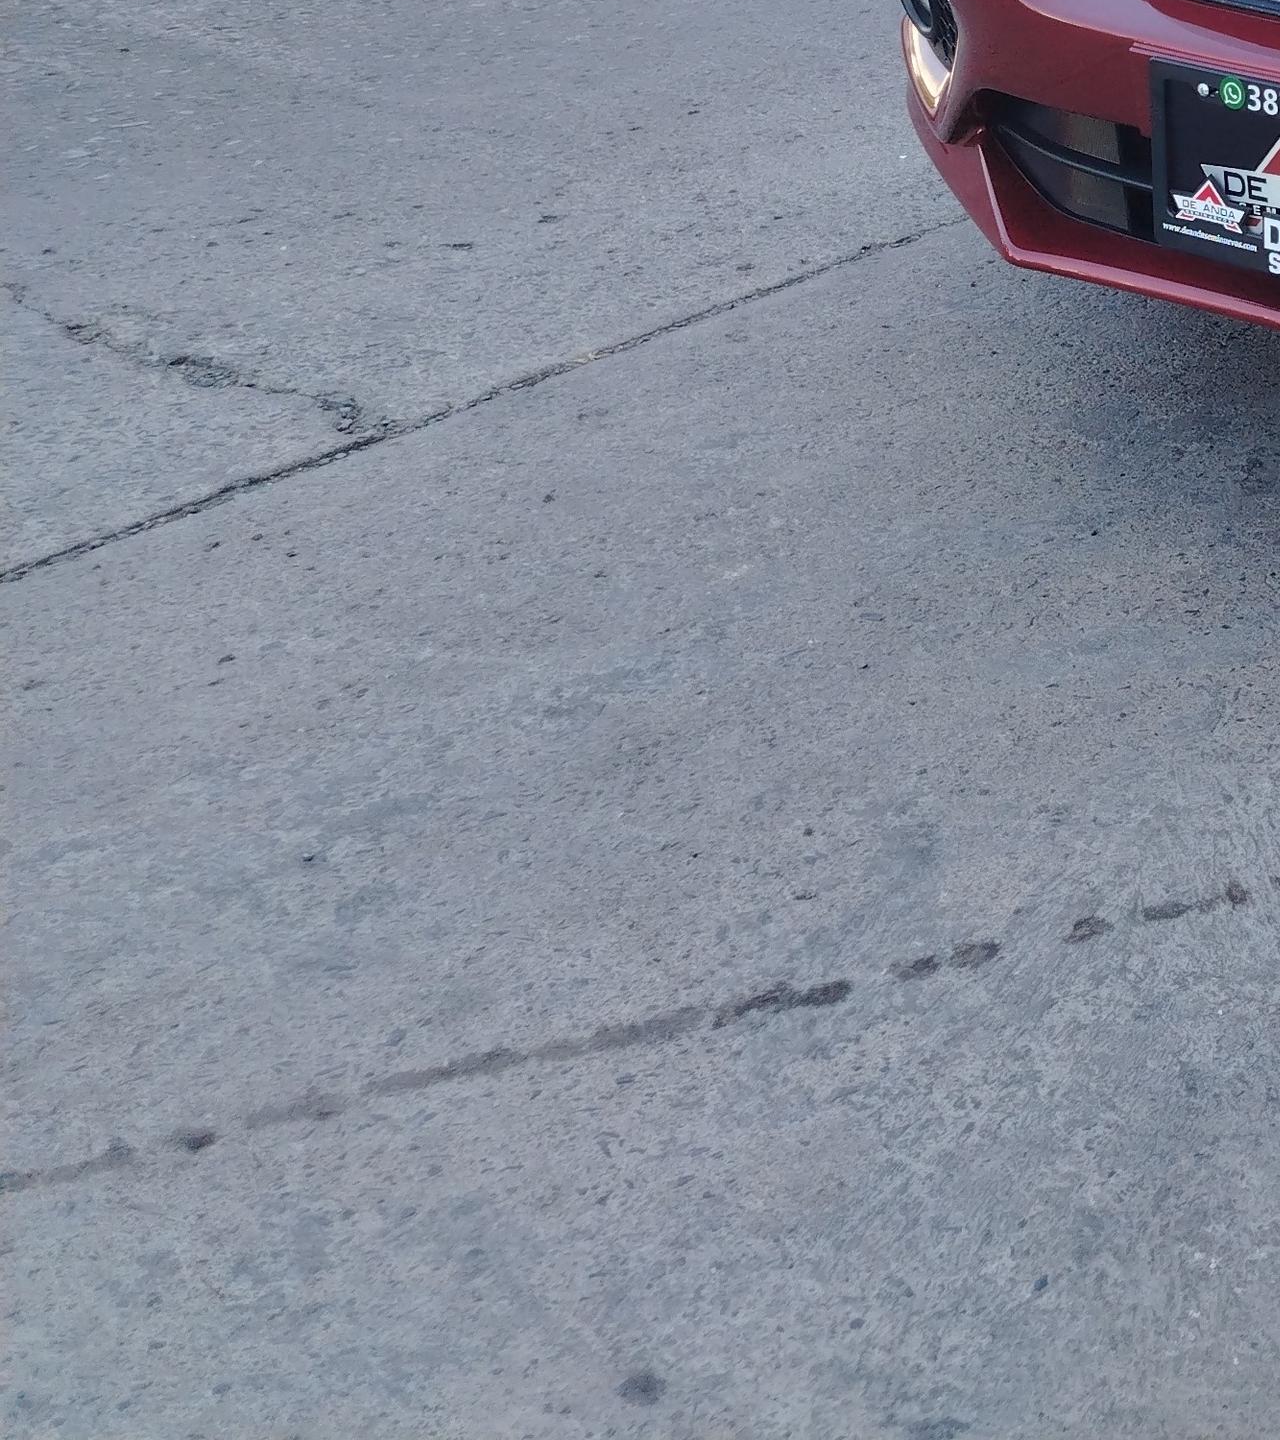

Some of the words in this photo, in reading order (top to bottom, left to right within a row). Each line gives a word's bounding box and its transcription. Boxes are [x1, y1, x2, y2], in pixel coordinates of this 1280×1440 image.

[1223, 170, 1268, 202] DE
[1182, 199, 1198, 210] DE
[1202, 203, 1237, 220] ANDA
